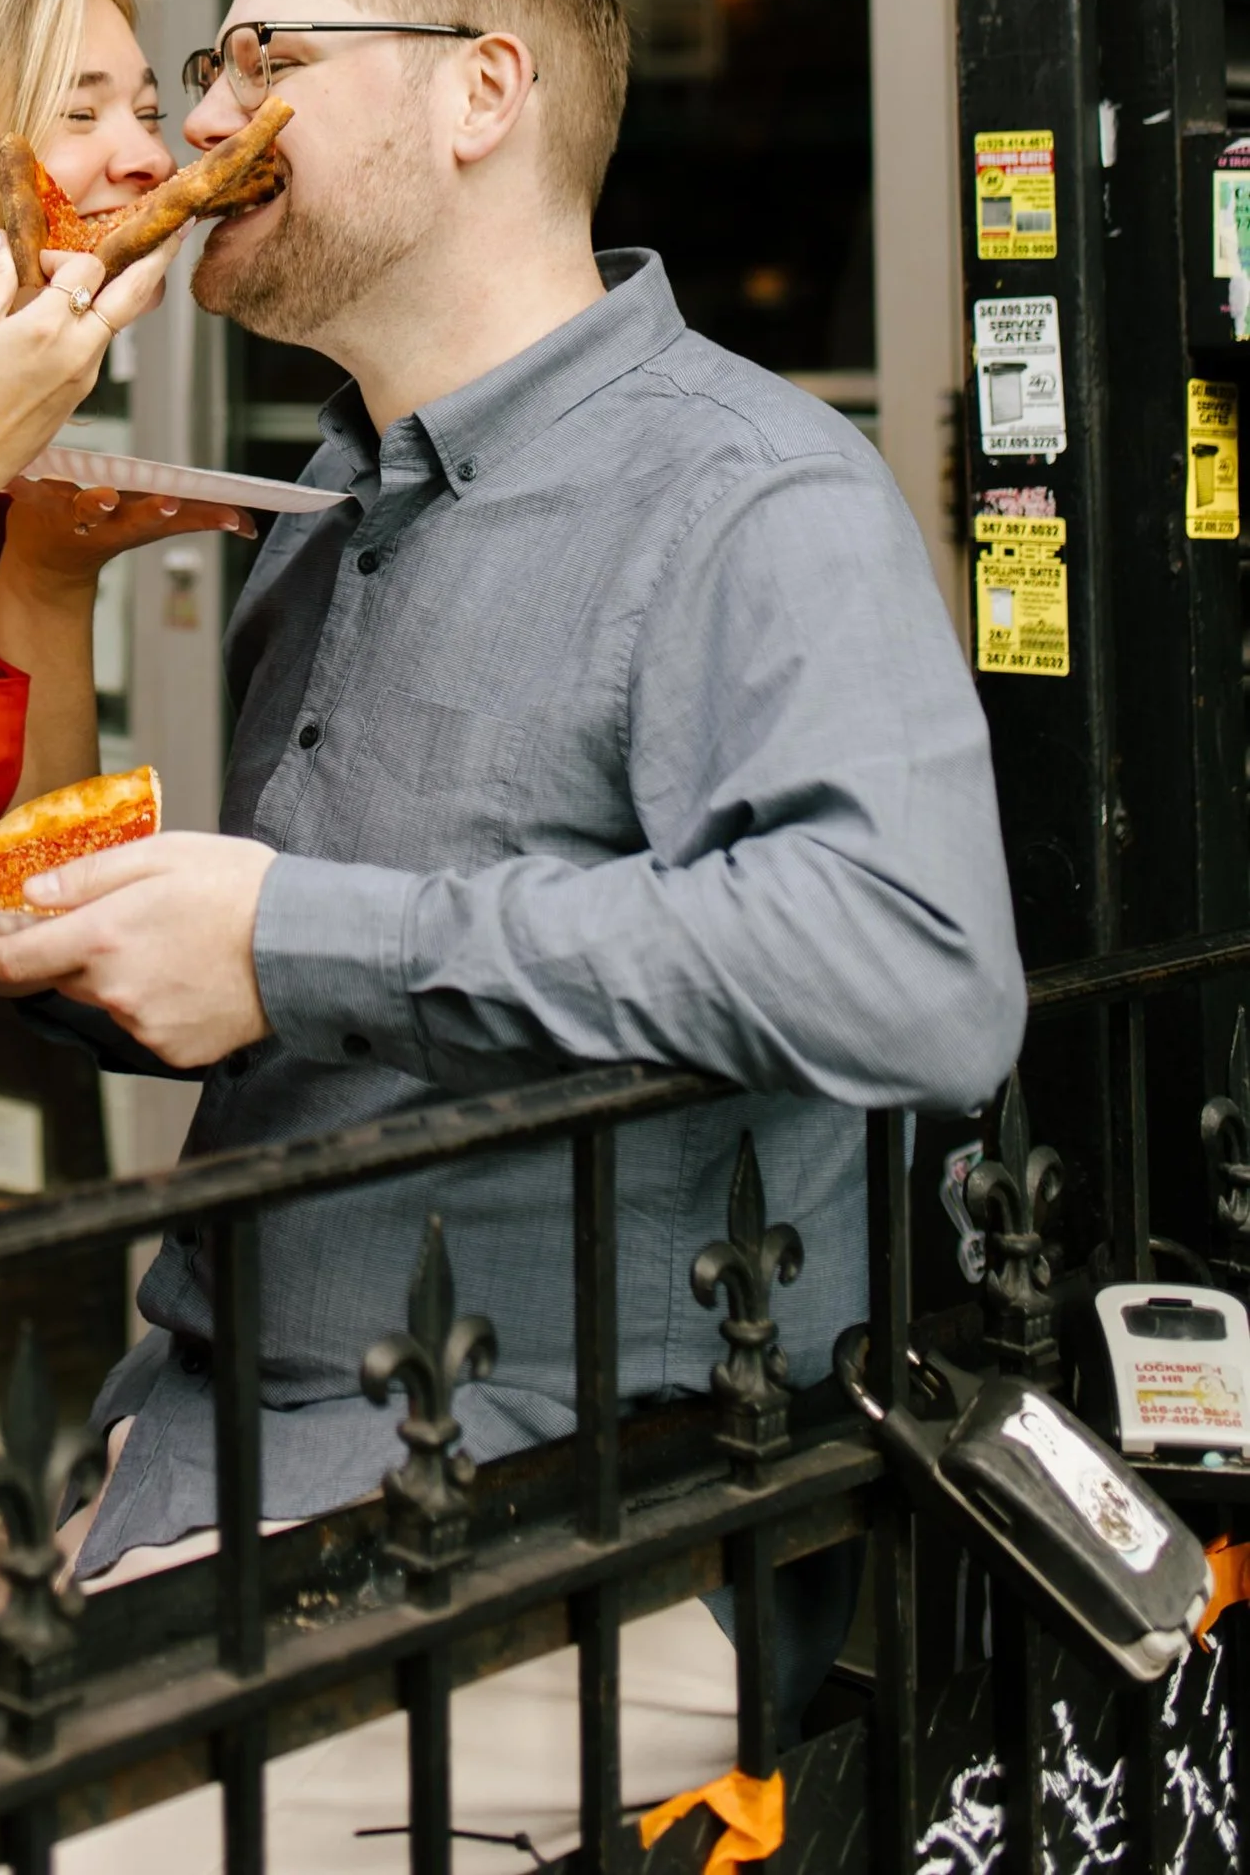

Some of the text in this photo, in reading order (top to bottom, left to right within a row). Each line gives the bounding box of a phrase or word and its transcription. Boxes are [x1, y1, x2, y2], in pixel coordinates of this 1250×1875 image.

[989, 319, 1046, 331] SERVICE
[994, 331, 1042, 344] GATES
[979, 542, 1062, 565] JOSE
[1029, 566, 1061, 579] GATES
[1135, 1363, 1222, 1375] LOCKSMIH
[1137, 1374, 1183, 1383] 24 HR
